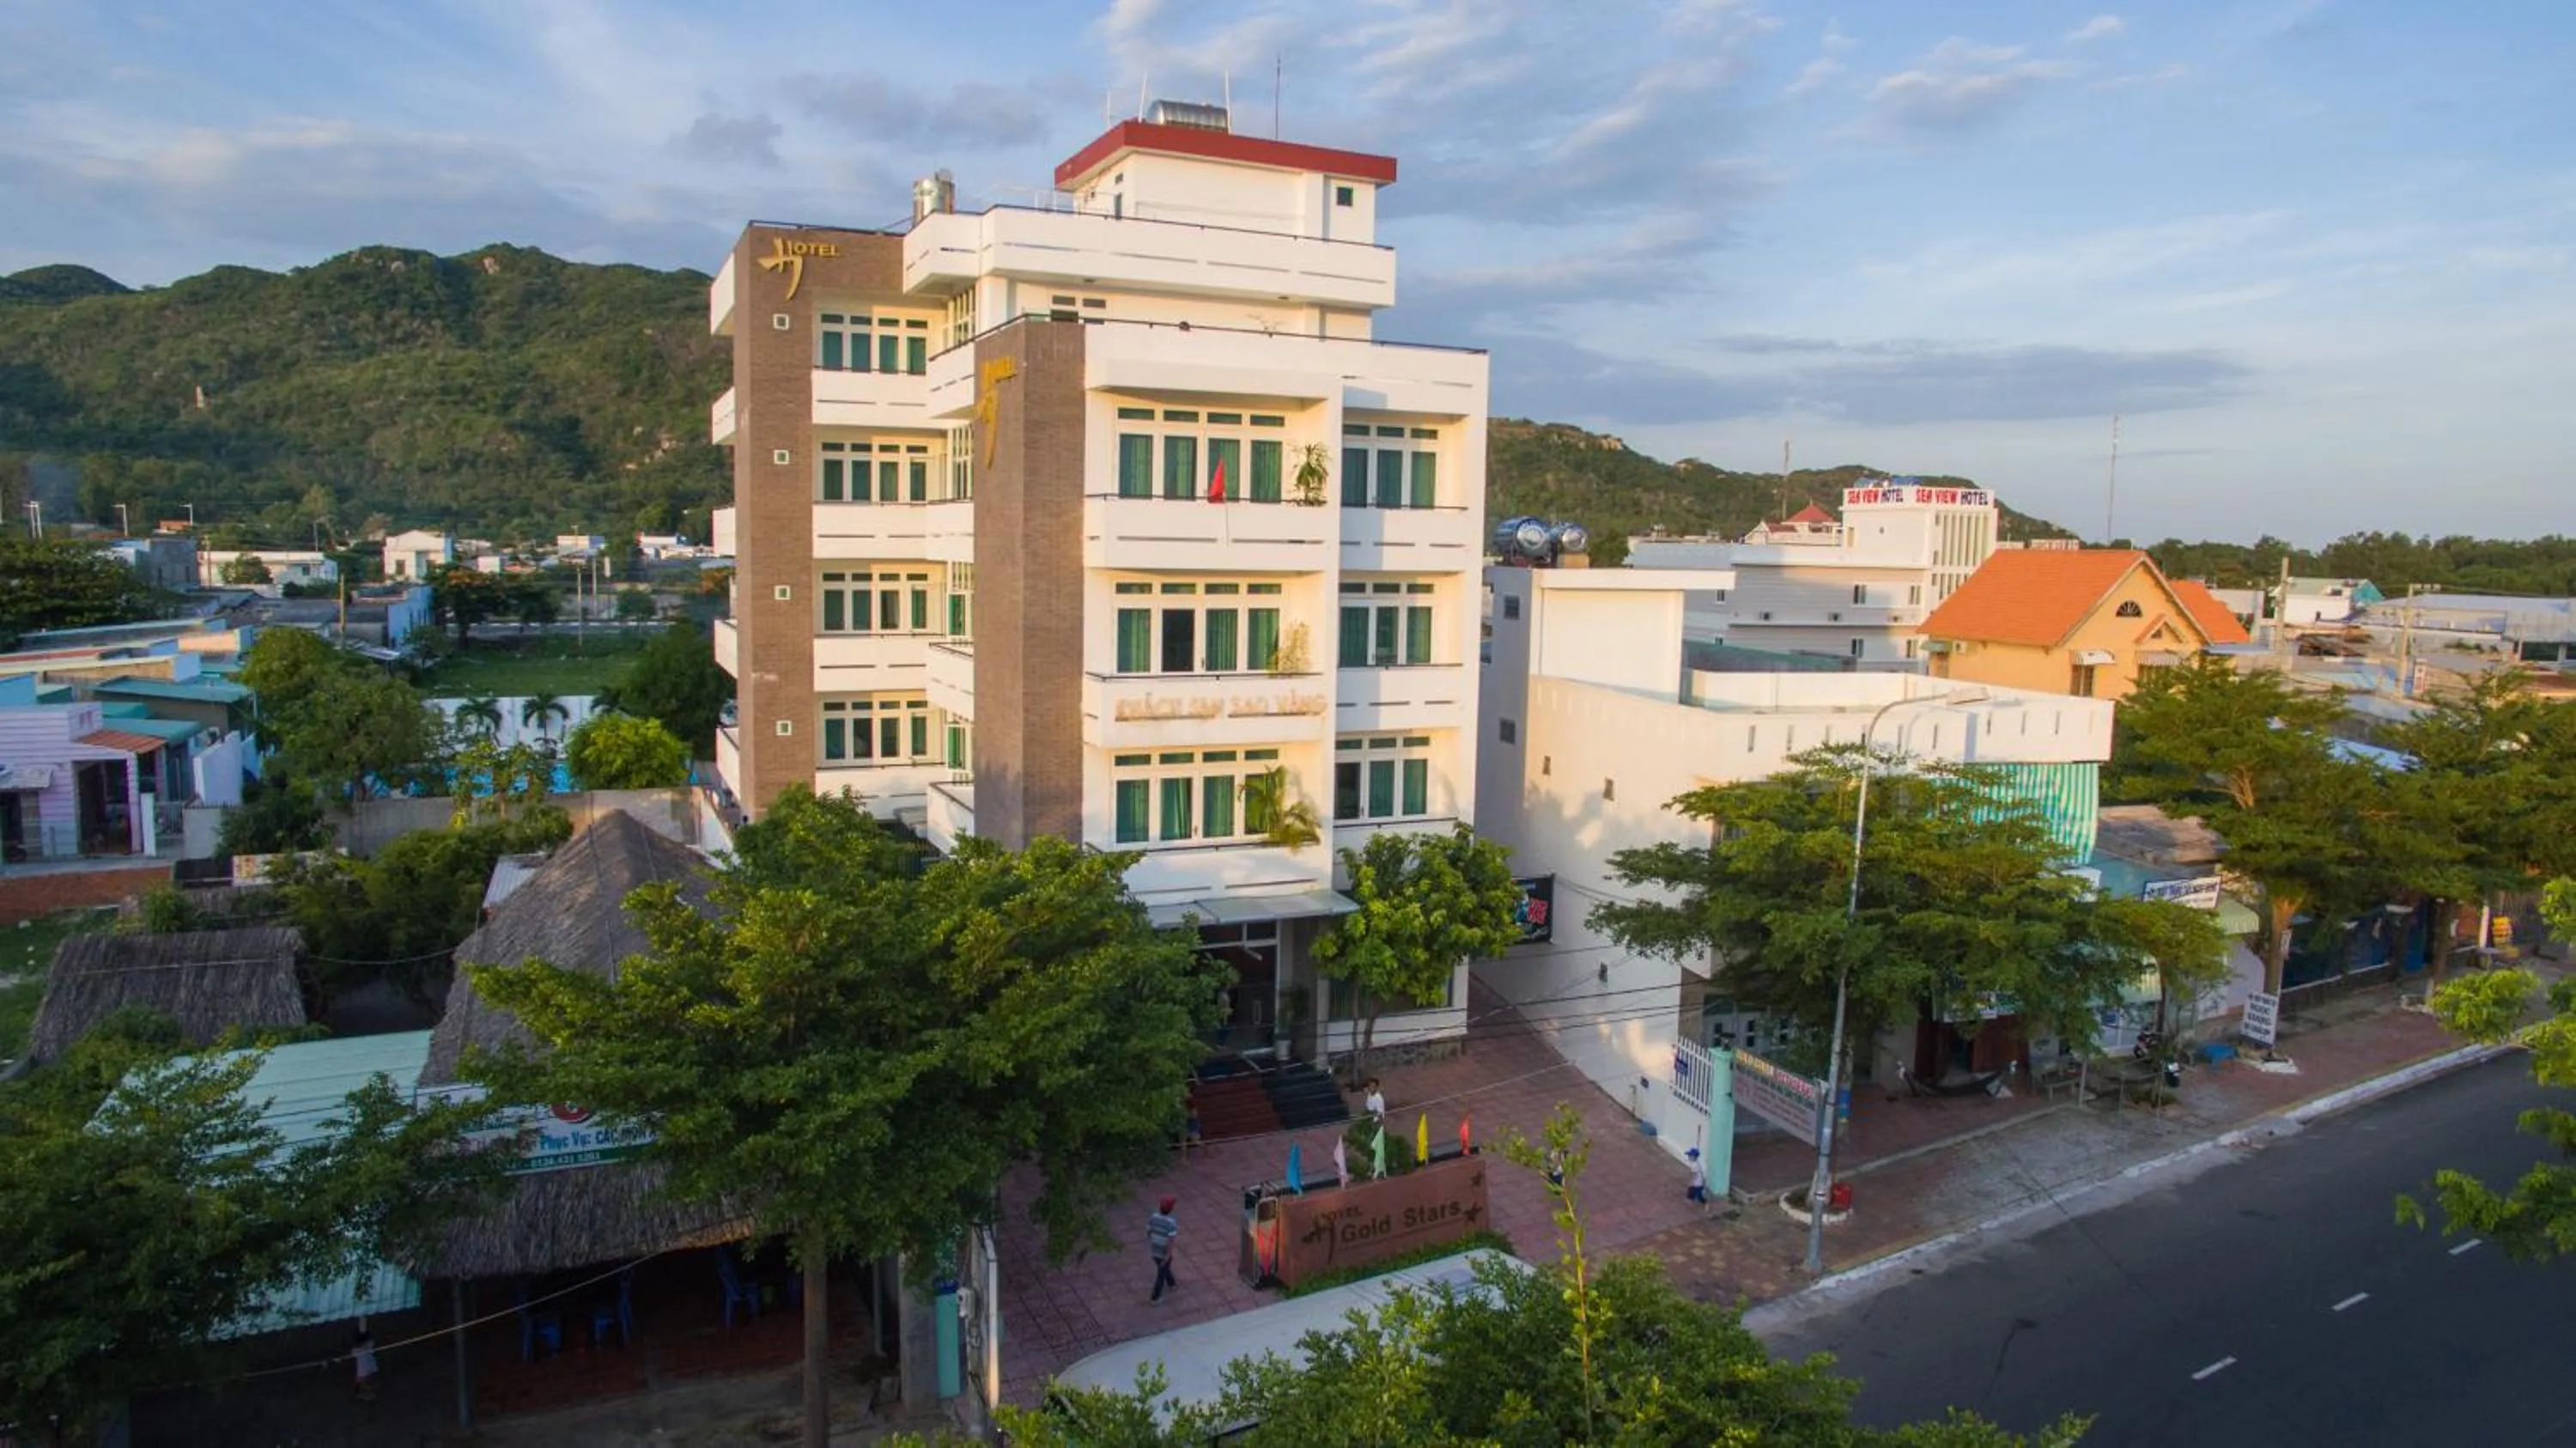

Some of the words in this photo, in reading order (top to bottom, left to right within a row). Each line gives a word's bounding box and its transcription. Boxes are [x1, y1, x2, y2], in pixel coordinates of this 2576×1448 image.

[756, 237, 840, 301] HOTEL
[1847, 490, 1861, 504] SEA
[1862, 489, 1880, 504] VIEW
[1880, 488, 1904, 504] HOTEL
[1916, 488, 1933, 503] SEA
[1935, 489, 1958, 505] VIEW
[1960, 490, 1989, 506] HOTEL
[1340, 1214, 1392, 1244] Gold
[1401, 1201, 1462, 1228] Stars
